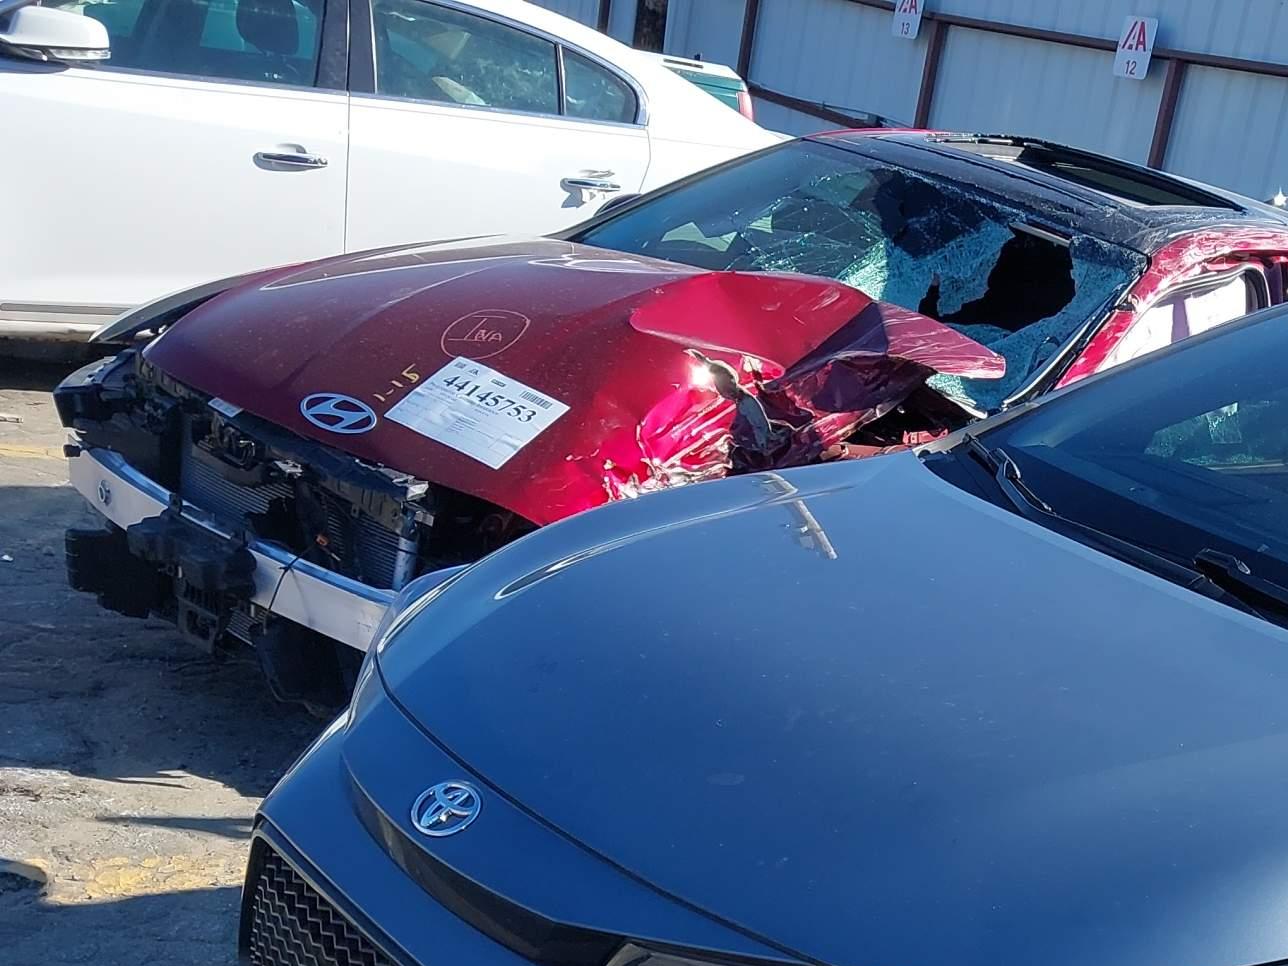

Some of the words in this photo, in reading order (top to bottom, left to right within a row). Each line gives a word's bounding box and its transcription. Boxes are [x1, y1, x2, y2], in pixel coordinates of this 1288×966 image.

[901, 22, 910, 35] 13
[1125, 60, 1137, 75] 12
[443, 374, 537, 424] 44145753
